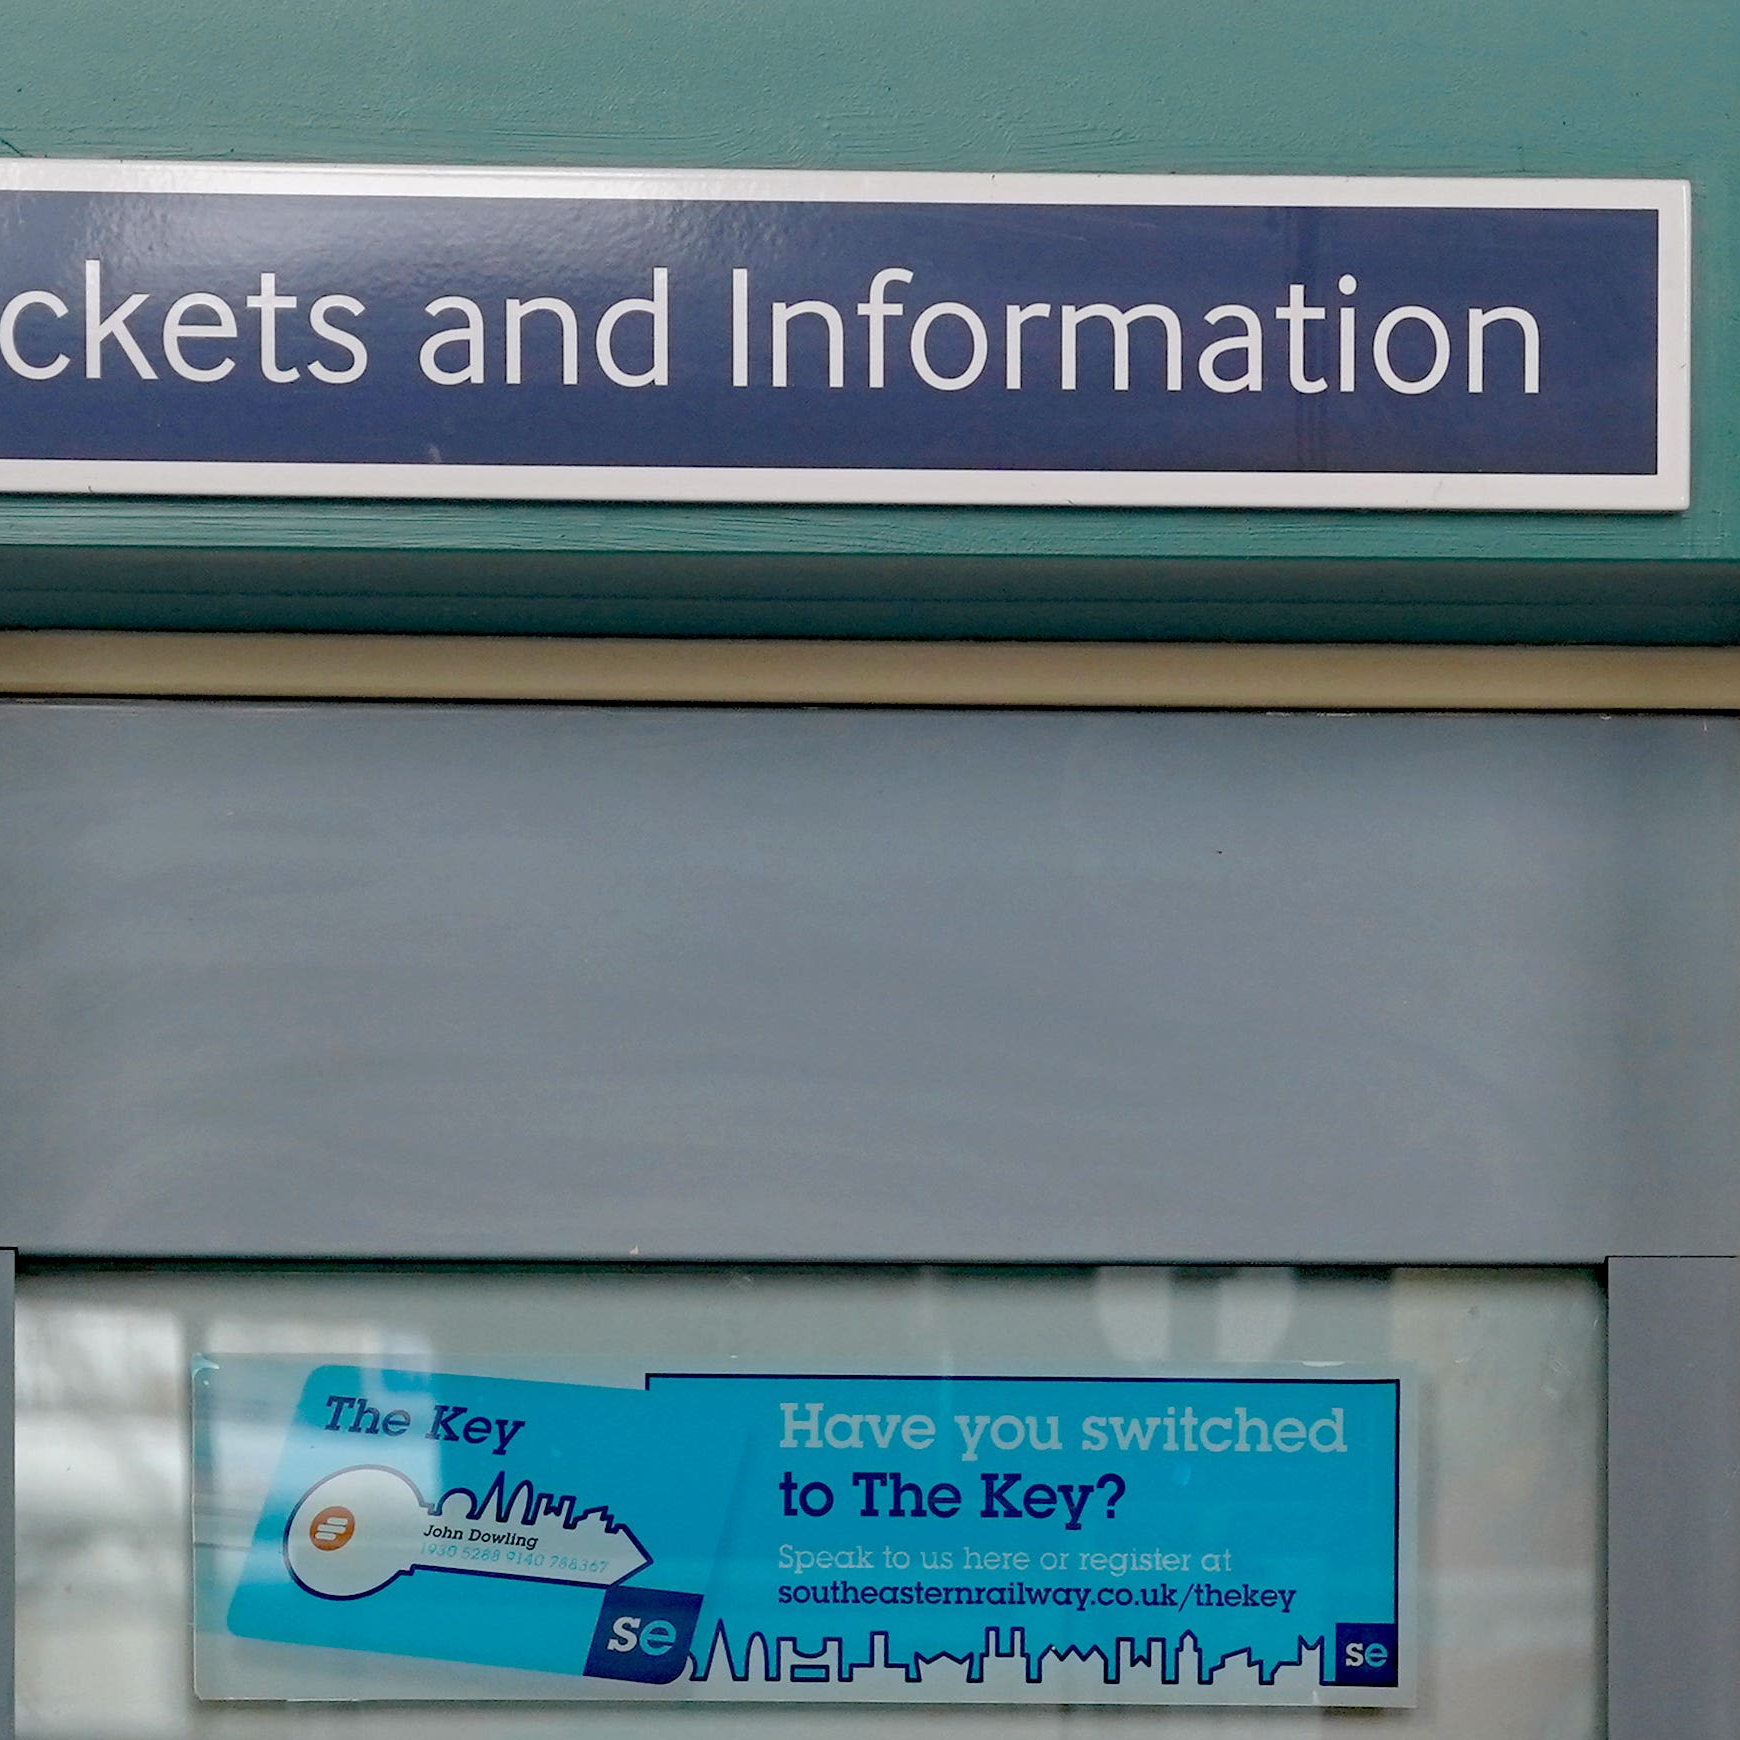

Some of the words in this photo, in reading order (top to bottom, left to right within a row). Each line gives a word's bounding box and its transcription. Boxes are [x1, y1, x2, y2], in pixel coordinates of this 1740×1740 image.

[420, 268, 668, 387] and
[733, 268, 1539, 394] Information
[323, 1396, 413, 1440] The
[425, 1404, 525, 1456] Key
[780, 1403, 936, 1449] Have
[954, 1415, 1062, 1461] you
[1082, 1407, 1347, 1452] switched
[779, 1472, 833, 1517] to
[853, 1472, 961, 1518] The
[981, 1473, 1125, 1530] Key?
[424, 1525, 463, 1540] John
[468, 1529, 538, 1550] Dowling
[779, 1544, 874, 1578] Speak
[883, 1546, 910, 1569] to
[921, 1552, 953, 1569] us
[963, 1547, 1030, 1570] here
[1040, 1553, 1069, 1570] or
[1079, 1548, 1191, 1577] register
[1201, 1549, 1231, 1571] at
[779, 1583, 1296, 1613] southeasternrailway.co.uk/thekey
[608, 1613, 675, 1658] se
[1345, 1637, 1386, 1668] se
